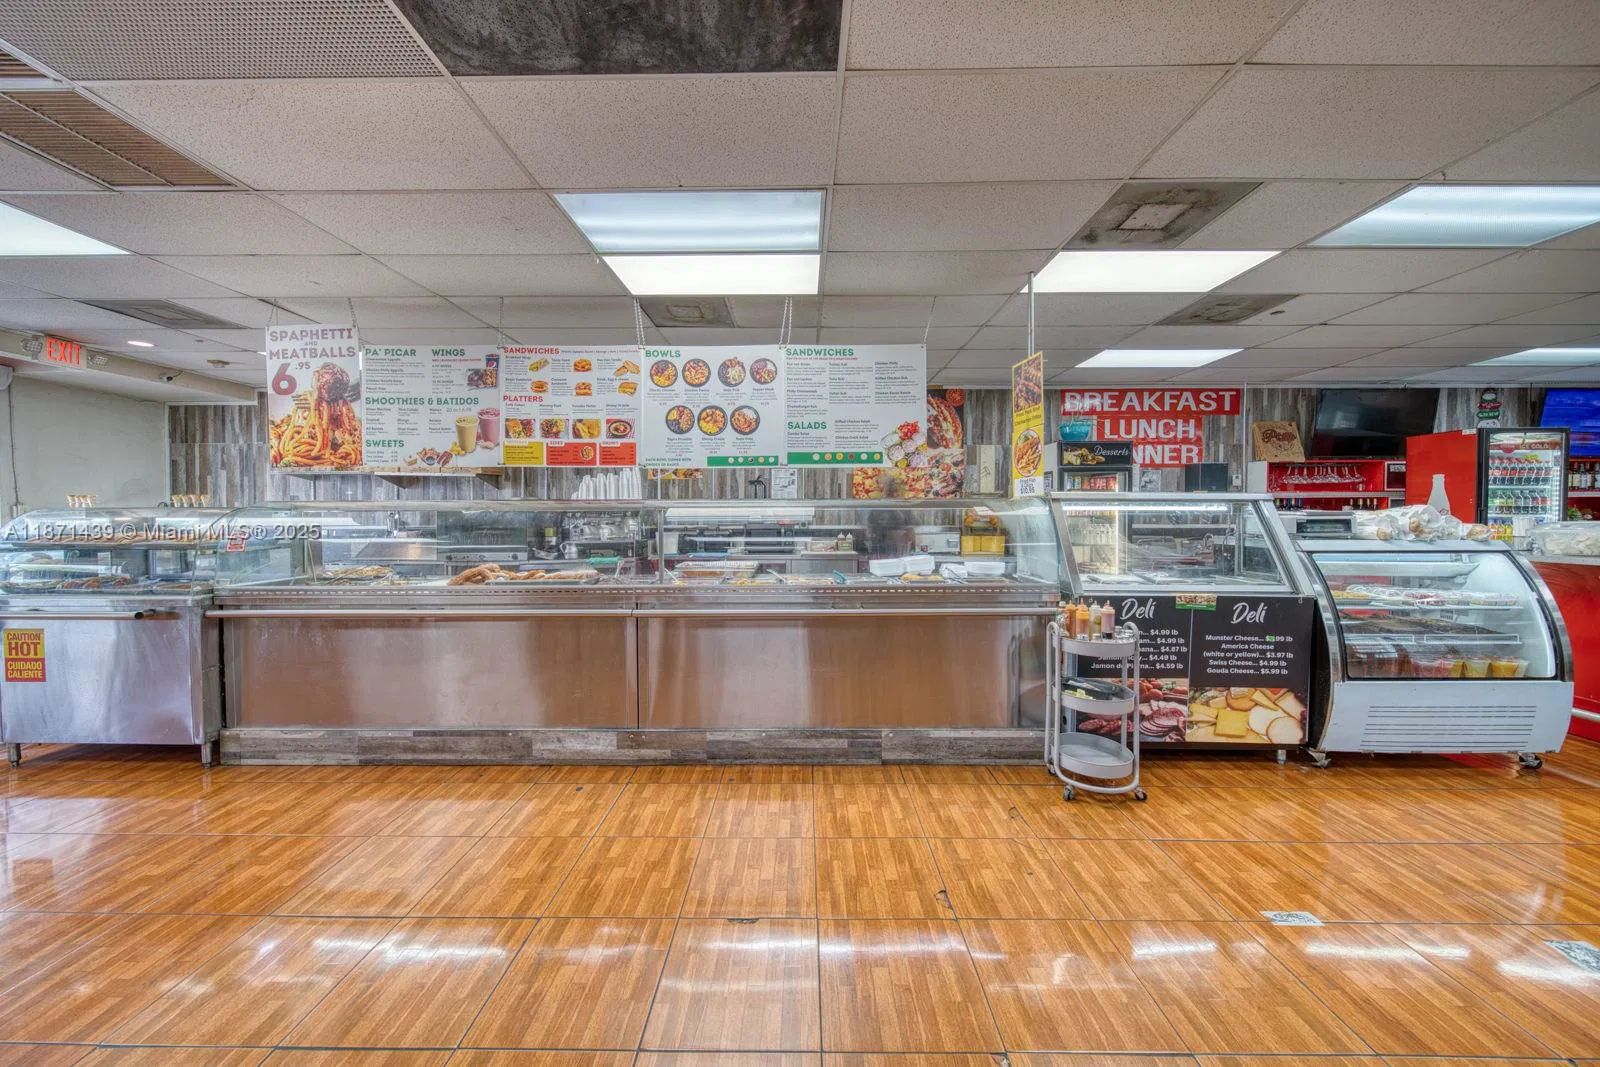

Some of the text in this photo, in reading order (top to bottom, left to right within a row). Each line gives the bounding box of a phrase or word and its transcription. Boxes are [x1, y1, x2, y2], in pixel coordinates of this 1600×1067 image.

[269, 327, 353, 341] SPAPHETTI
[47, 337, 81, 367] EXIT
[269, 346, 356, 360] MEATBALLS
[385, 348, 417, 356] PICAR
[431, 348, 465, 356] WINGS
[645, 350, 681, 358] BOWLS
[786, 348, 854, 356] SANDWICHES
[272, 362, 297, 396] 6
[365, 397, 480, 405] SMOOTHIES & BATIDOS
[1064, 391, 1236, 412] BREAKFAST
[787, 421, 827, 430] SALADS
[1104, 418, 1195, 439] LUNCH
[365, 439, 405, 447] SWEETS
[1093, 445, 1129, 457] Desserts
[1133, 444, 1199, 465] NNER
[1120, 598, 1157, 620] Deli
[1230, 601, 1268, 624] Deli
[7, 632, 41, 641] CAUTION
[1157, 637, 1176, 645] $4.99
[8, 641, 41, 656] HOT
[1234, 651, 1265, 659] yellow)...
[8, 661, 42, 670] CUIDADO
[1155, 662, 1176, 670] $4.59
[1228, 659, 1258, 667] Cheese...
[8, 670, 43, 679] CALIENTE
